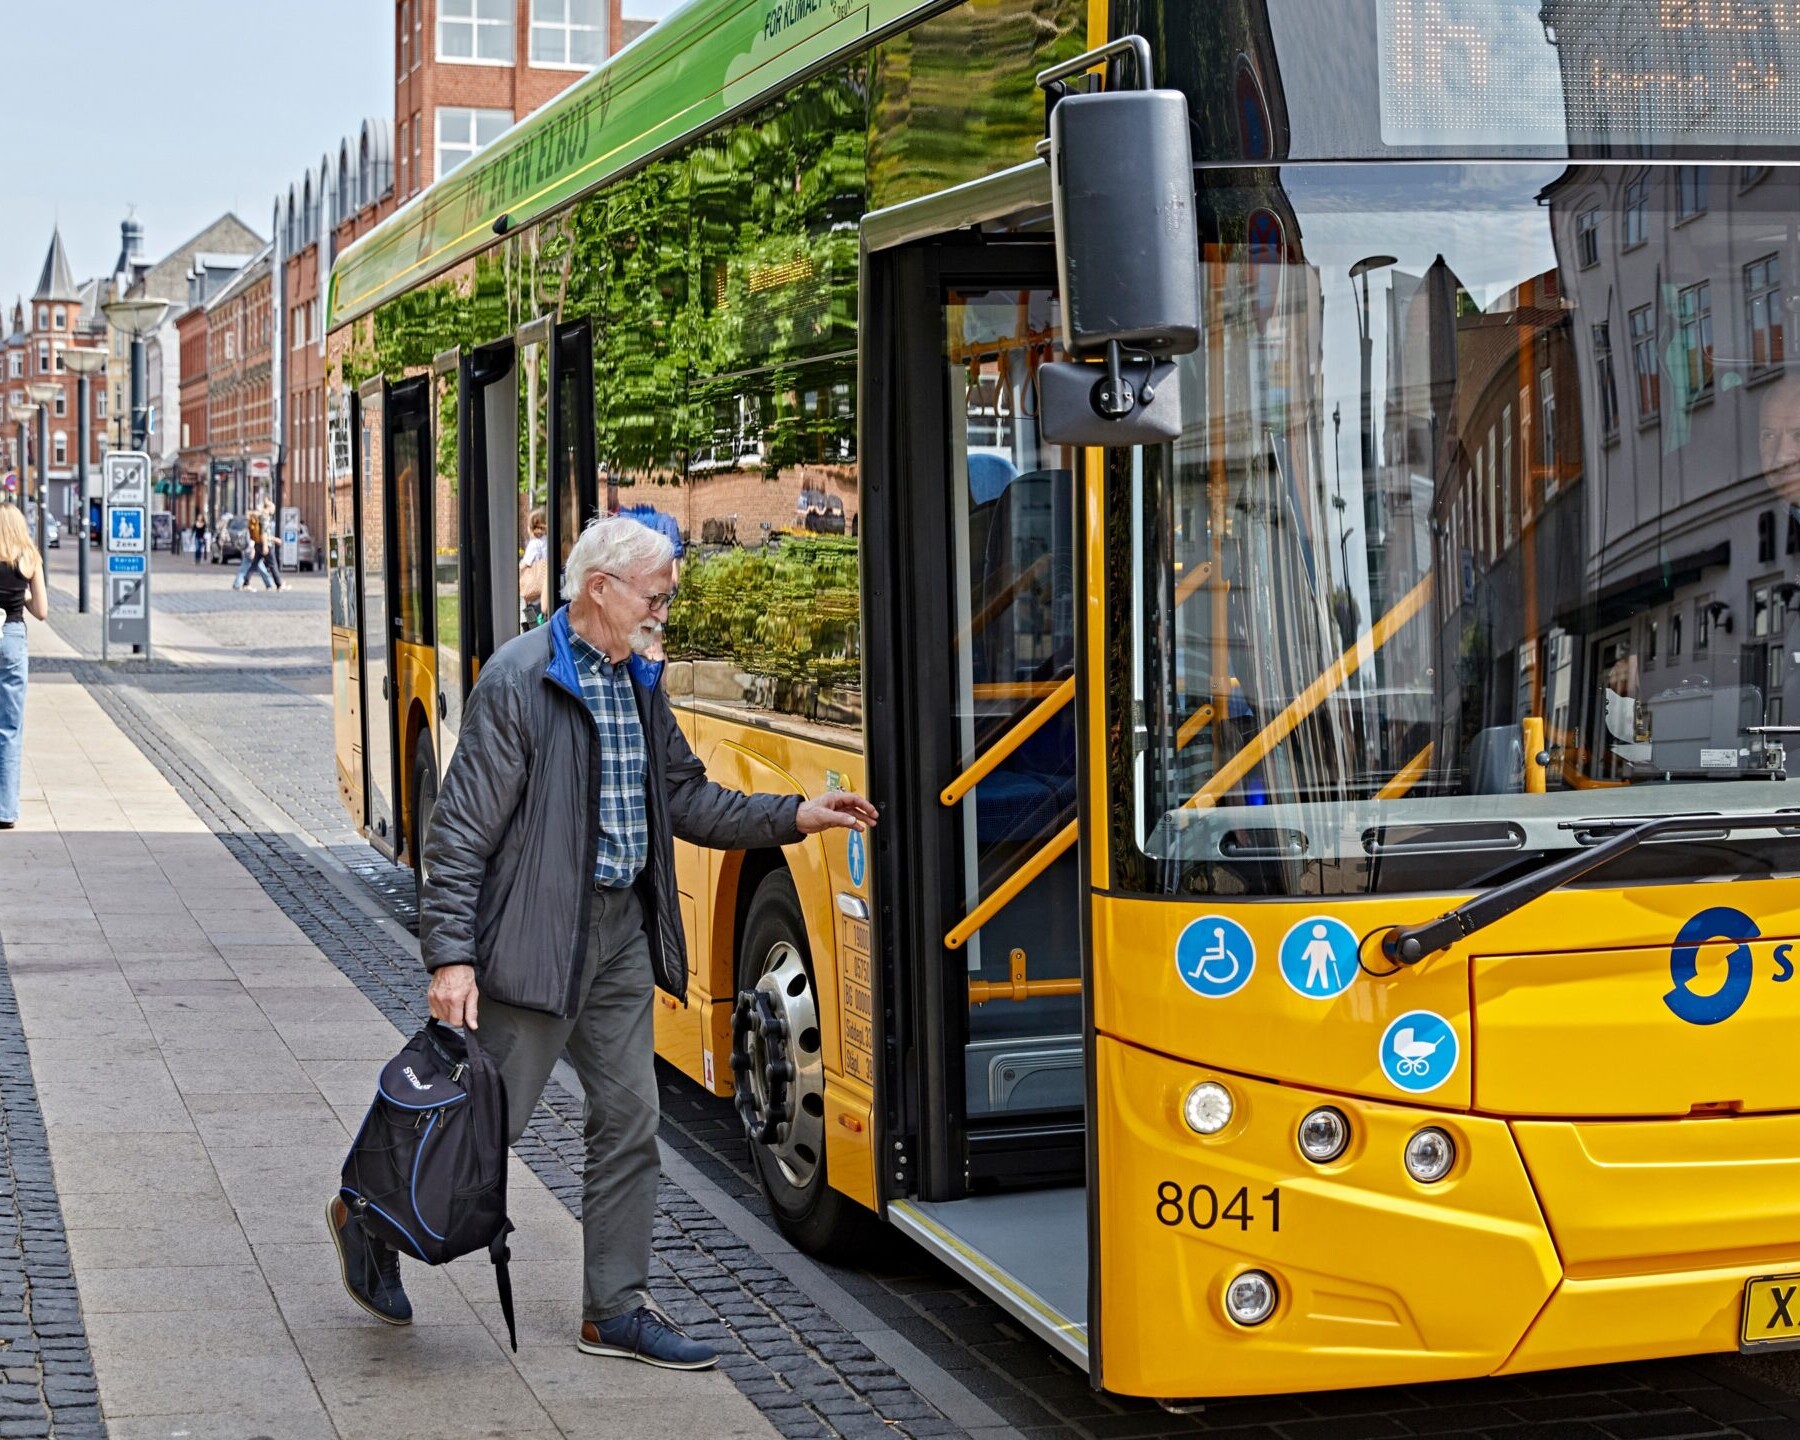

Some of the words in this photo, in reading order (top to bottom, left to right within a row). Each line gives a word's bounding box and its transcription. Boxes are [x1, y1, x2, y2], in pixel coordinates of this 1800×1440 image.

[764, 5, 783, 41] FOR
[511, 133, 535, 199] EN
[536, 94, 594, 185] ELBUS
[113, 467, 140, 485] 30
[845, 983, 853, 1007] BG
[1156, 1180, 1280, 1232] 8041
[1766, 1285, 1800, 1329] X
